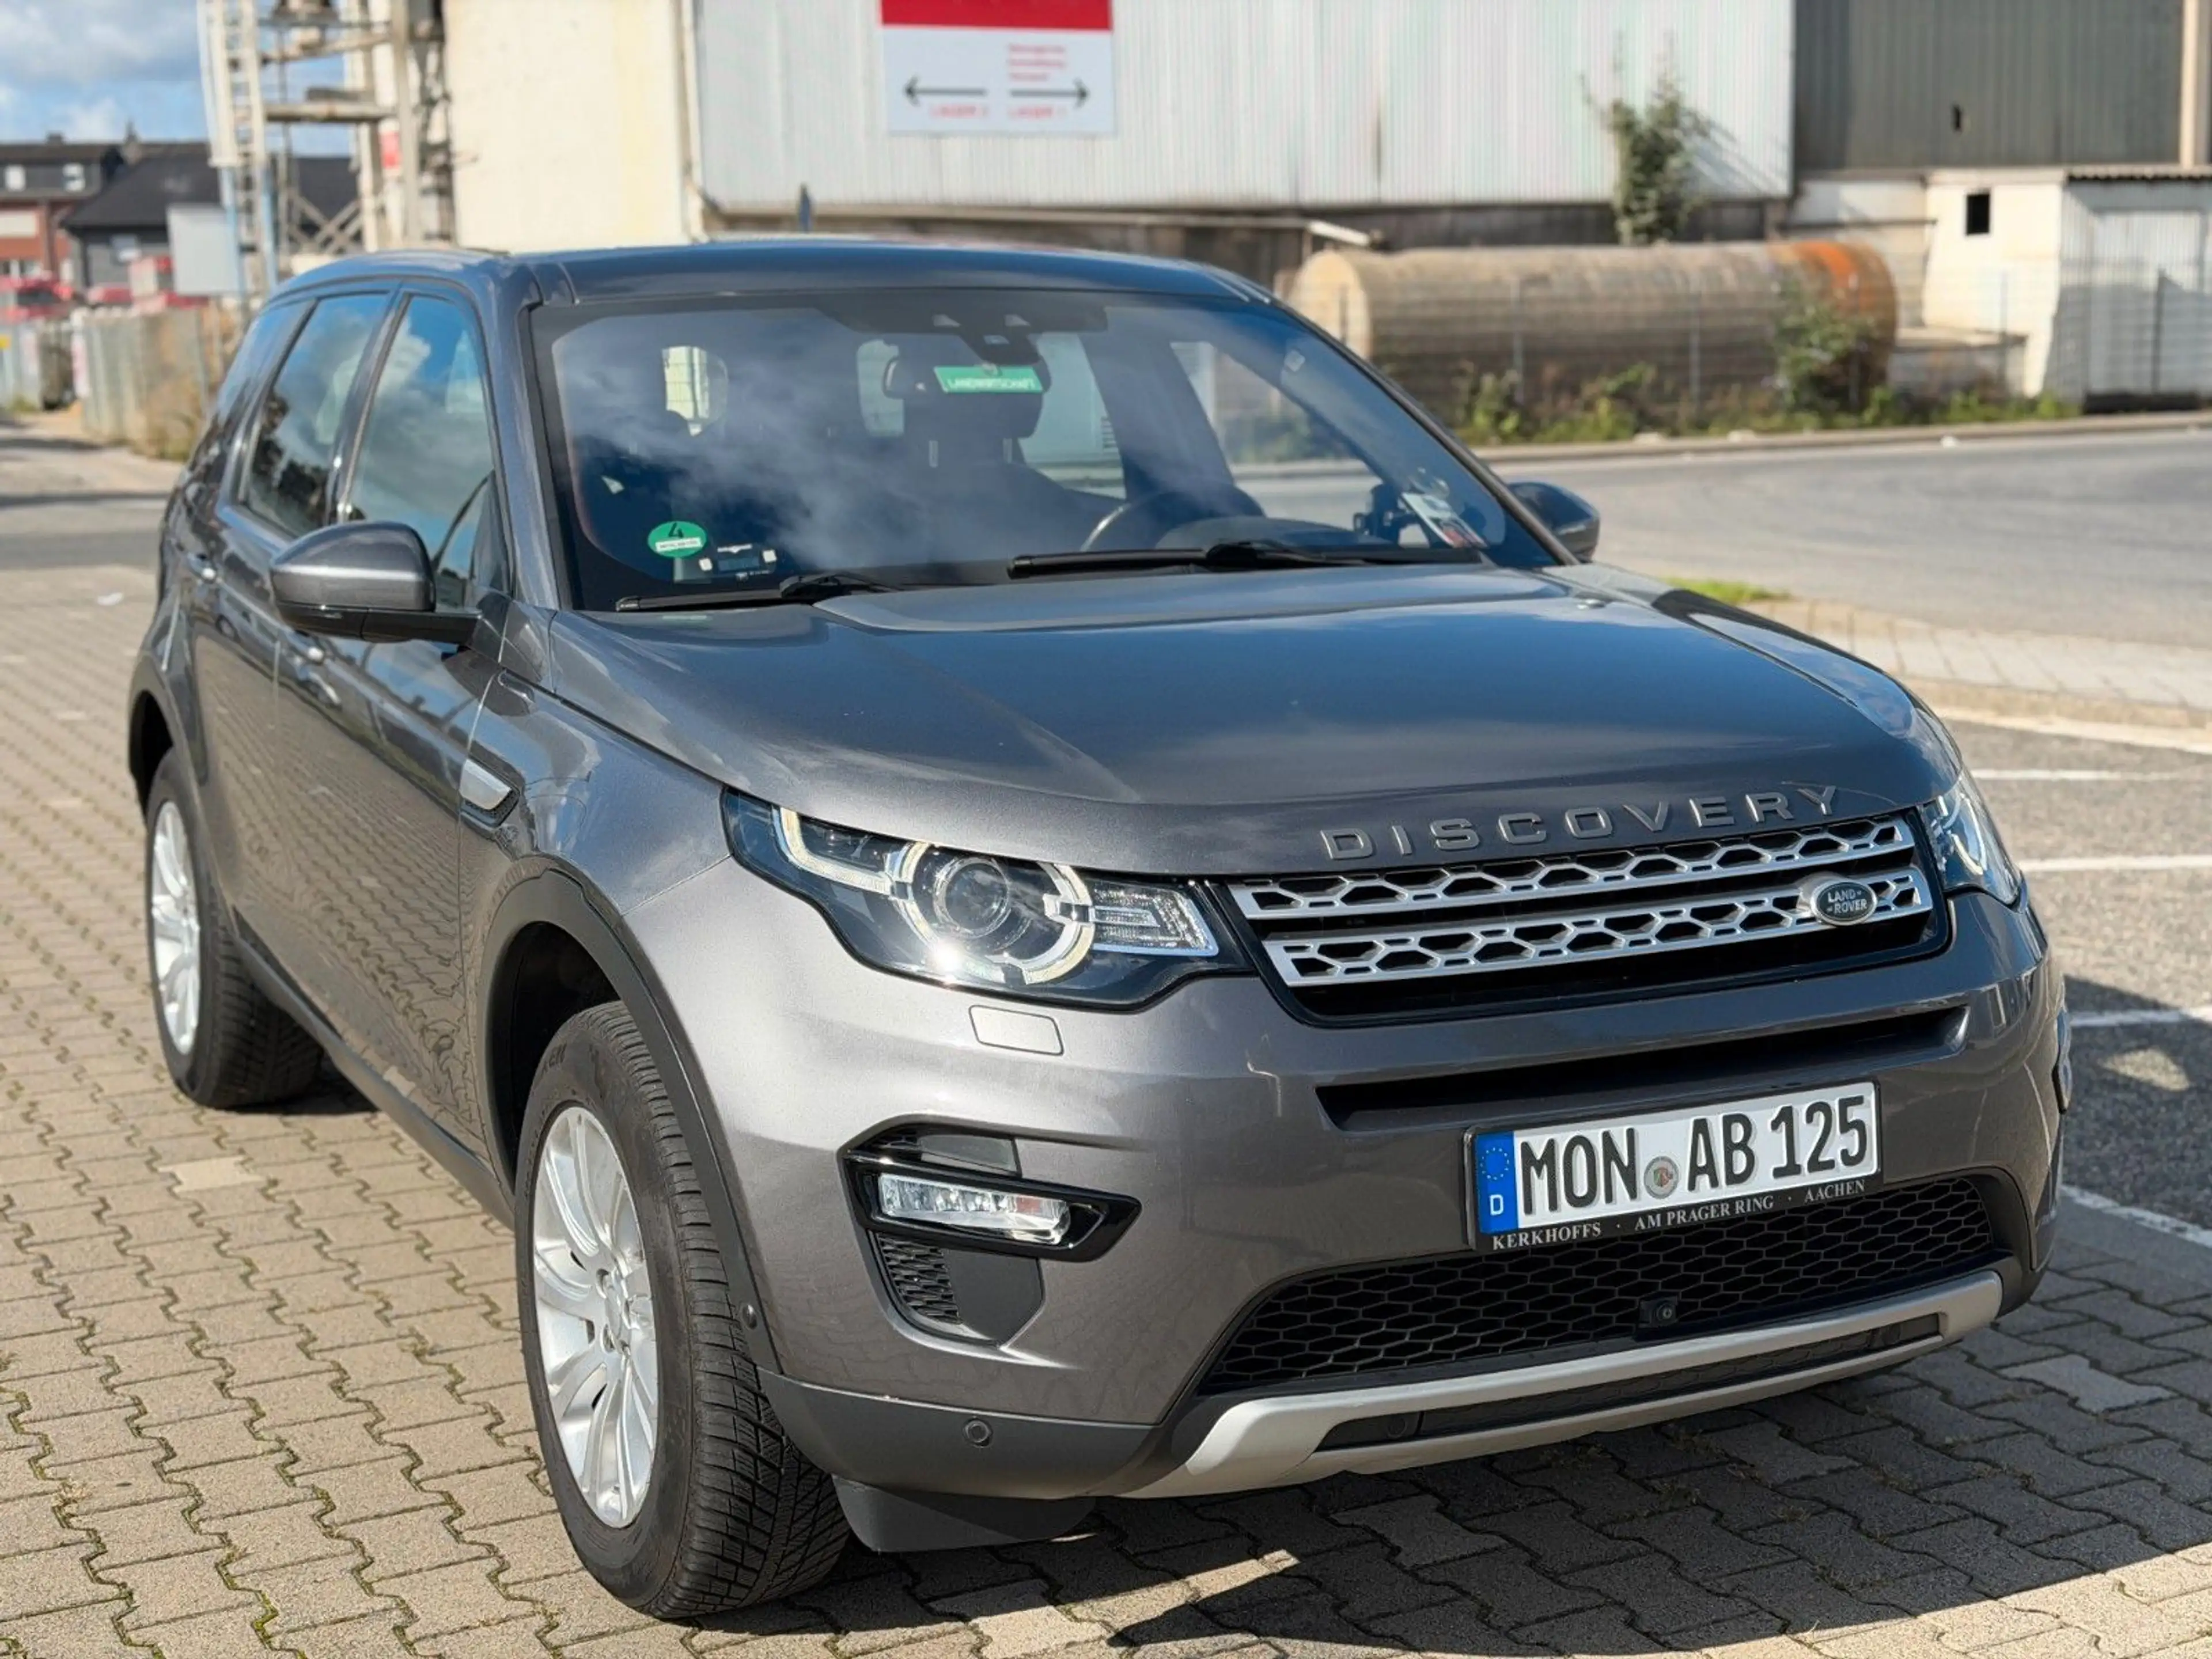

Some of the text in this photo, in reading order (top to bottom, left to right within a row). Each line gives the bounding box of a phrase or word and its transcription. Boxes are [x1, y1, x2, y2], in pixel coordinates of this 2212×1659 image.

[668, 522, 683, 538] 4
[1319, 785, 1837, 861] DISCOVERY
[1828, 889, 1856, 902] LAND
[1834, 899, 1867, 914] ROVER
[1521, 1095, 1867, 1215] MON AB 125
[1490, 1194, 1504, 1215] D
[1493, 1180, 1865, 1251] KERKHOFFS AM PRAGER RING AACHEN
